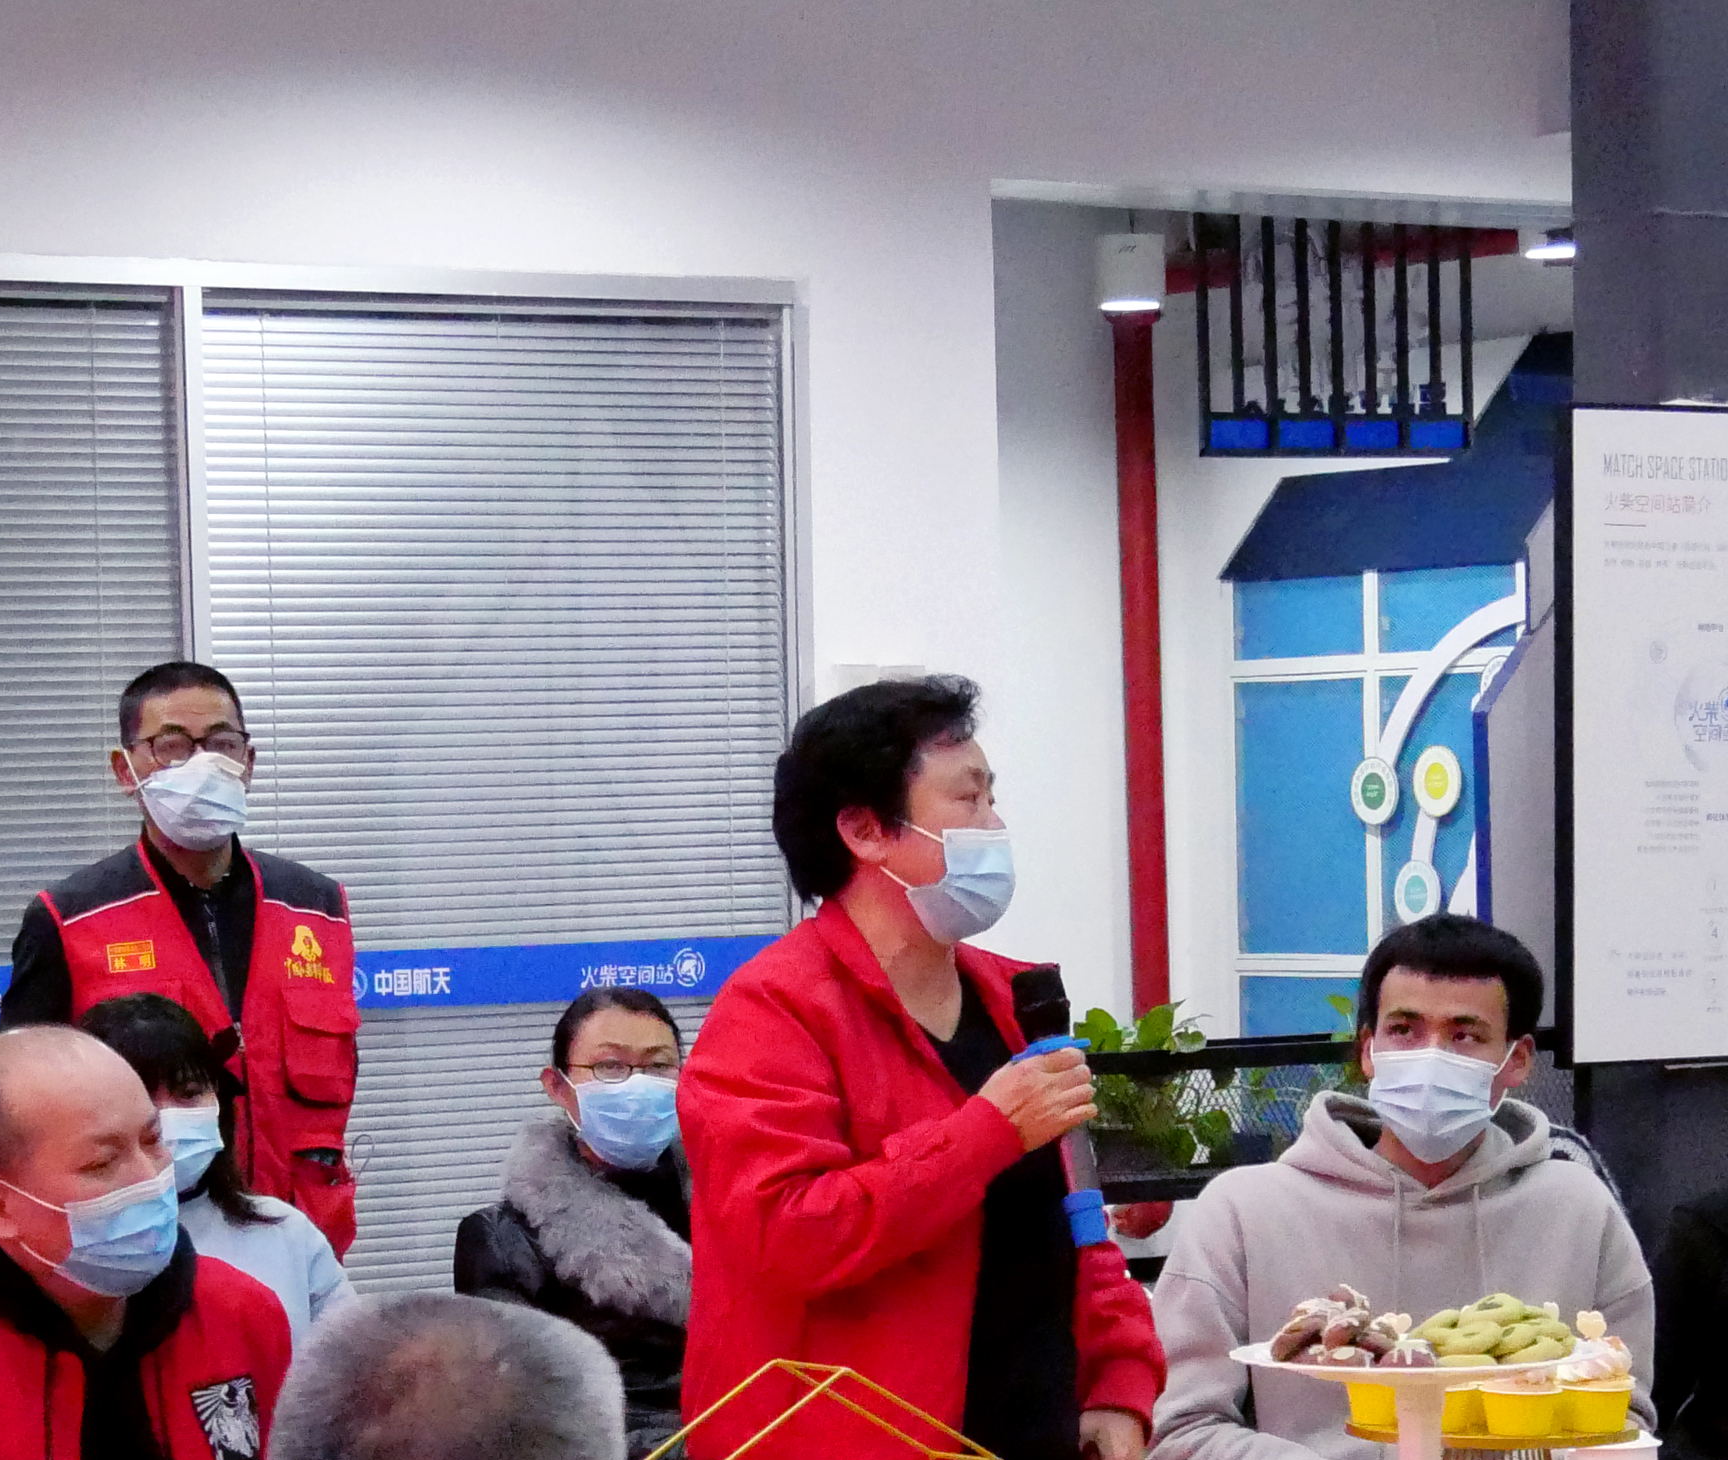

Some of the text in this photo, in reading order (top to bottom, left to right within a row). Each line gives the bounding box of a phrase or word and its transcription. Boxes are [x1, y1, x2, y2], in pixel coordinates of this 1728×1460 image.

[1603, 453, 1643, 479] MATCH
[1647, 455, 1684, 480] SPACE
[373, 966, 452, 997] 中国航天
[580, 963, 675, 989] 火柴空间站
